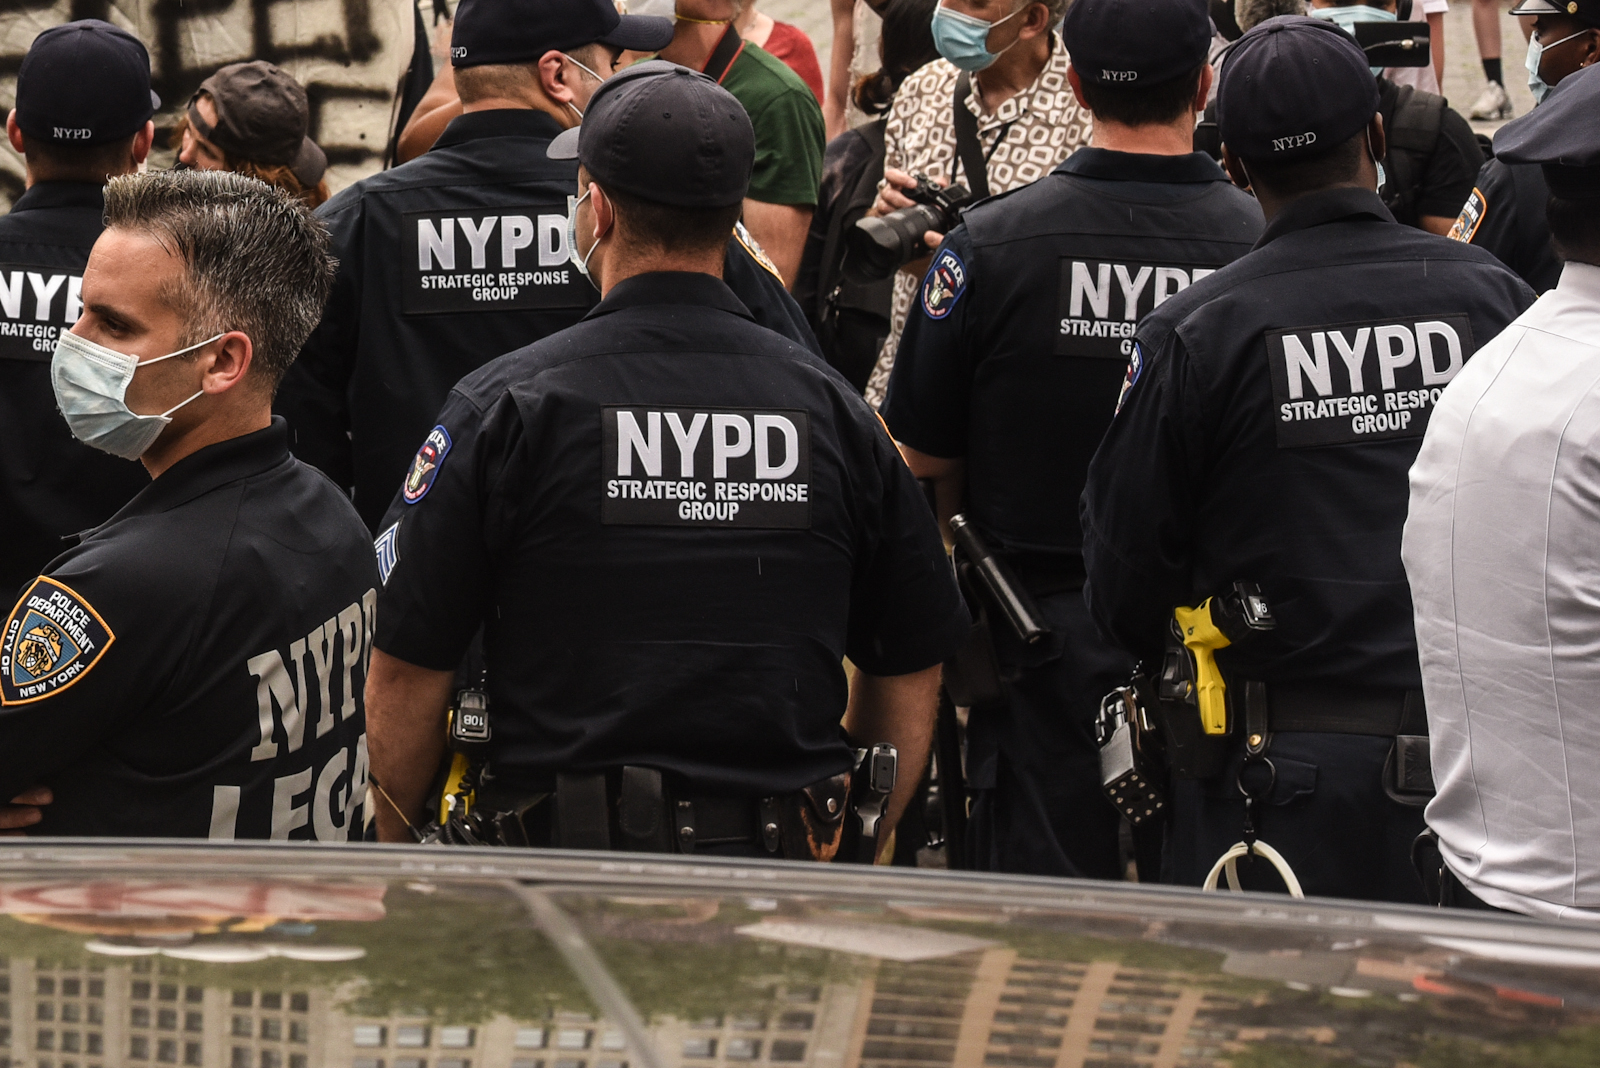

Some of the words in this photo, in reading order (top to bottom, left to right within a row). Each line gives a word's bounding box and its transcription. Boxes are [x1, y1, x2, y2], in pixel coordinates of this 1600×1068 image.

[1101, 69, 1138, 82] NYPD
[53, 126, 92, 140] NYPD
[1272, 131, 1317, 152] NYPD
[418, 214, 568, 270] NYPD
[420, 273, 495, 289] STRATEGIC
[498, 270, 569, 288] RESPONSE
[941, 255, 964, 288] POLICE
[472, 287, 519, 302] GROUP
[1282, 320, 1463, 400] NYPD
[1280, 394, 1378, 422] STRATEGIC
[1352, 411, 1412, 434] GROUP
[616, 411, 799, 479] NYPD
[607, 479, 707, 501] STRATEGIC
[714, 482, 808, 502] RESPONSE
[678, 500, 740, 521] GROUP
[49, 591, 91, 629] POLICE
[4, 619, 20, 652] CITY
[27, 596, 95, 654] DEPARTMENT
[1, 655, 10, 675] OF
[20, 682, 46, 698] NEW
[48, 661, 85, 688] YORK
[463, 714, 484, 726] 10B
